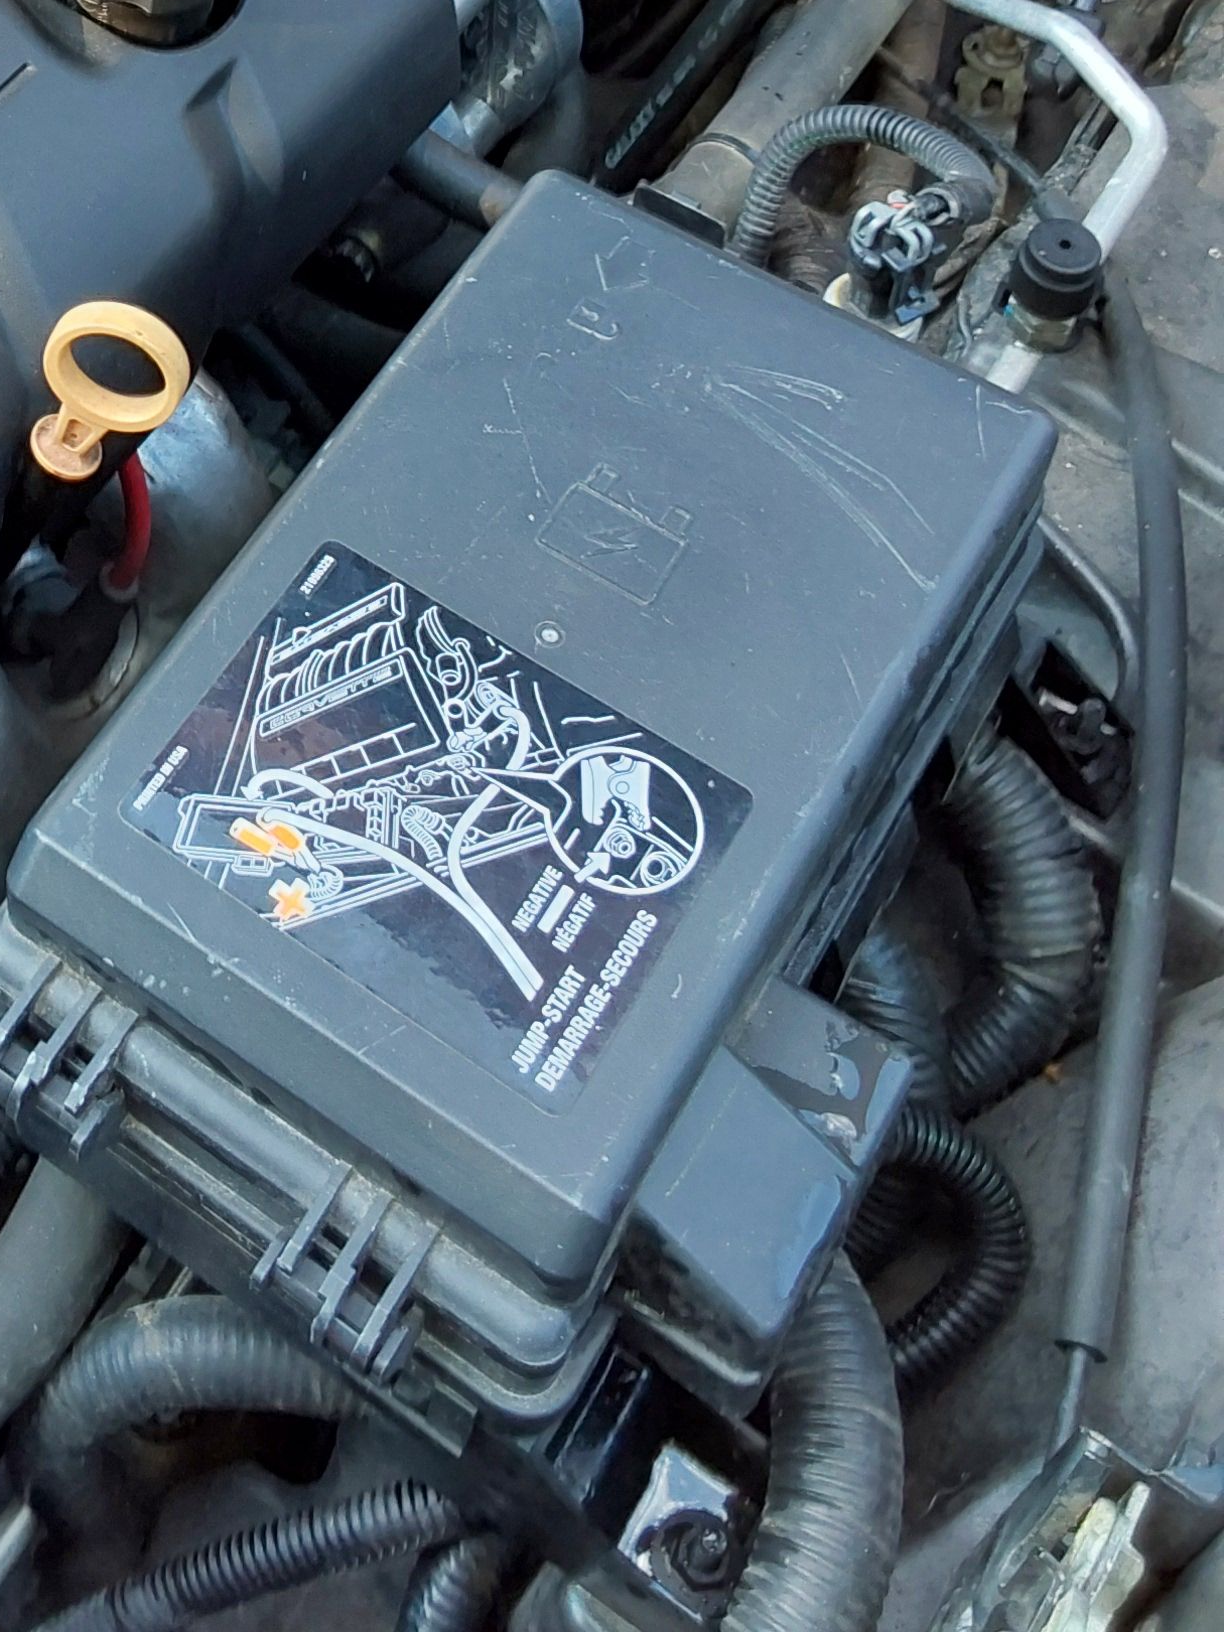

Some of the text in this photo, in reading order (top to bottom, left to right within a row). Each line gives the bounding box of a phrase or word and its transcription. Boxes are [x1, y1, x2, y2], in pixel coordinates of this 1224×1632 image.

[132, 742, 189, 811] PRINTED IN USA
[511, 863, 563, 932] NEGATIVE
[550, 892, 597, 953] NÉGATIF
[511, 964, 586, 1075] JUMP-START
[534, 908, 657, 1093] DEMARRAGE-SECOURS
